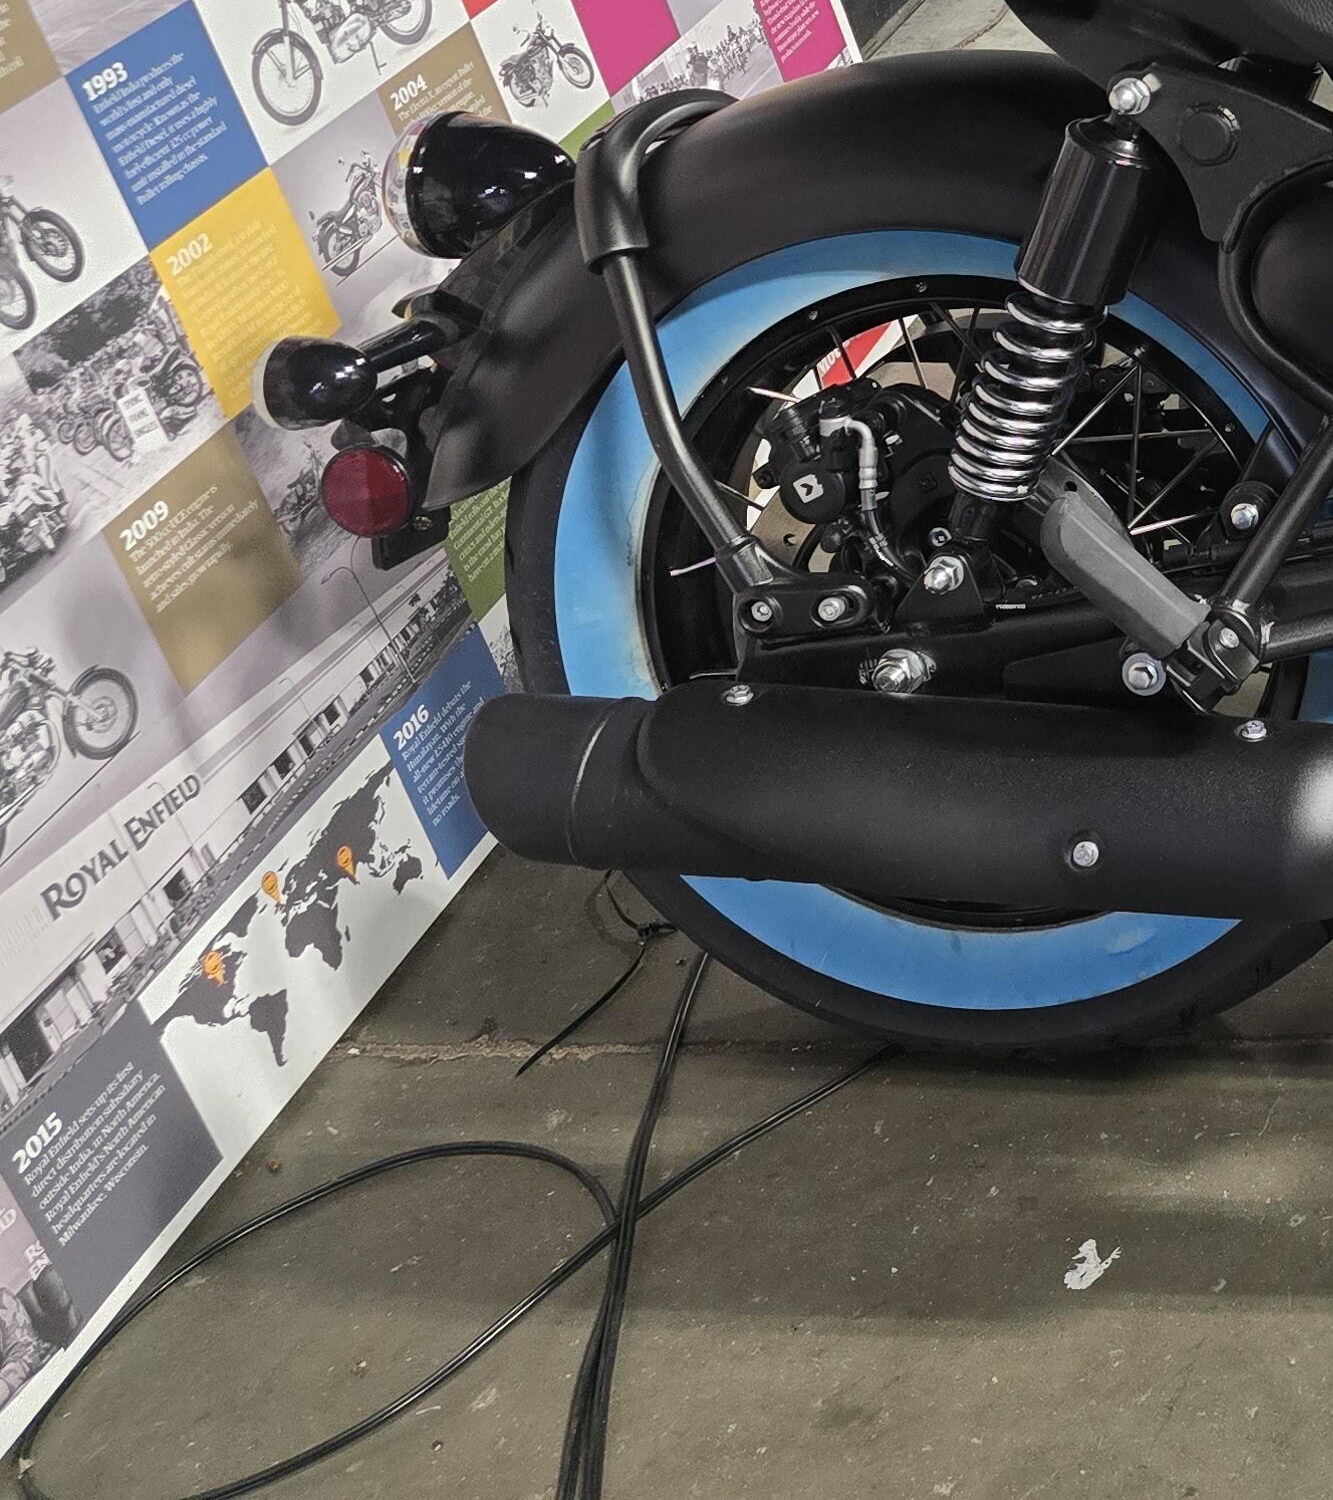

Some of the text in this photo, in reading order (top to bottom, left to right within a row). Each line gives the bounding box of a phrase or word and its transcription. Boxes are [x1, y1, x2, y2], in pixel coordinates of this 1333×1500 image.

[81, 61, 128, 101] 1993
[390, 74, 427, 110] 2004
[167, 232, 213, 276] 2002
[119, 501, 169, 551] 2009
[392, 704, 430, 750] 2016
[402, 681, 471, 760] Royal Enfield debuts the
[40, 773, 201, 921] ROYAL ENFIELD
[12, 1112, 63, 1174] 2015
[24, 1154, 50, 1185] Royal
[48, 1120, 79, 1158] Enfield
[94, 1092, 107, 1107] up
[32, 1167, 56, 1197] direct
[56, 1115, 104, 1169] distribution
[103, 1070, 142, 1117] subsidiary
[39, 1172, 69, 1209] outside
[101, 1109, 126, 1138] North
[45, 1190, 70, 1222] Royal
[103, 1126, 128, 1154] North
[128, 1085, 165, 1128] American
[52, 1172, 106, 1234] headquarters
[105, 1156, 118, 1174] are
[116, 1122, 147, 1158] located
